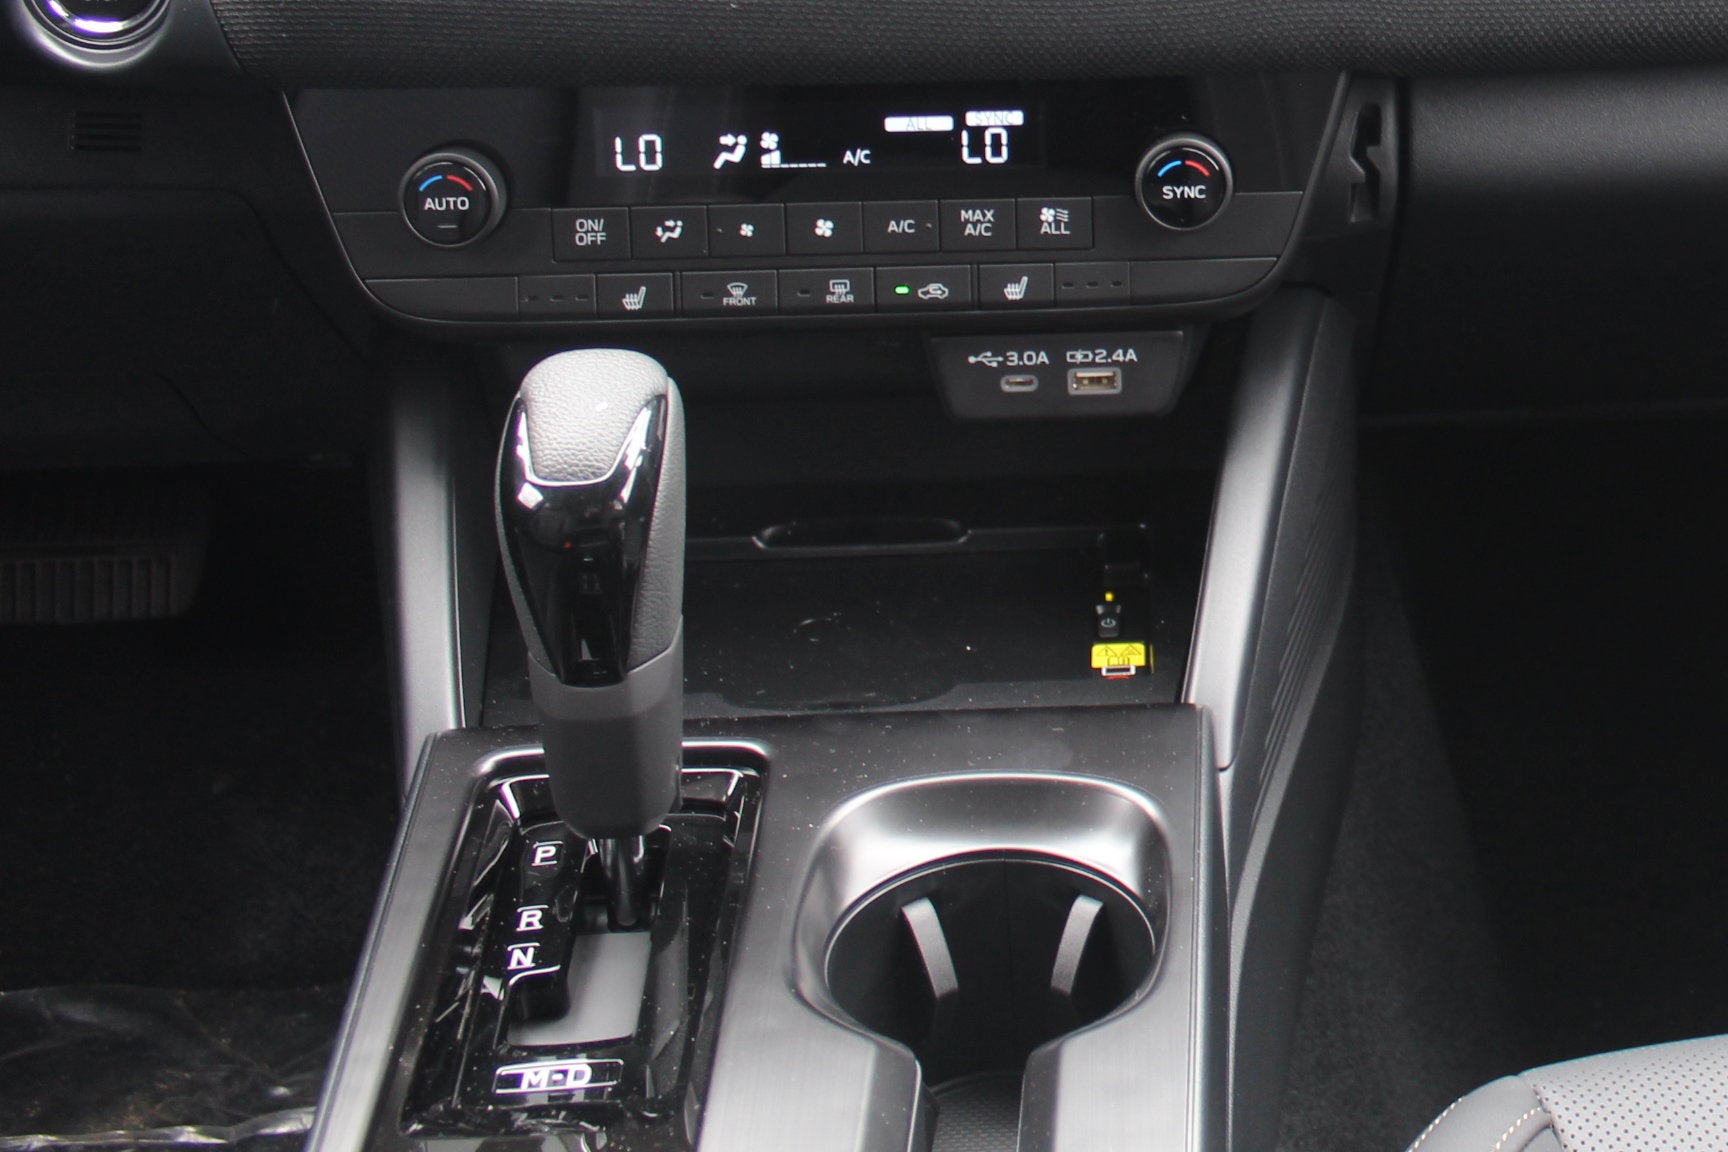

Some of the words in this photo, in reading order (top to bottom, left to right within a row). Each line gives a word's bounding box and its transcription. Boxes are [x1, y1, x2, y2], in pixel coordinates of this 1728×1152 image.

[905, 116, 933, 131] ALL
[974, 111, 1016, 126] SYNC
[614, 133, 664, 172] LO
[960, 126, 1008, 164] LO
[842, 149, 872, 166] A/C
[1161, 185, 1206, 200] SYNC
[424, 196, 470, 212] AUTO
[960, 209, 995, 222] MAX
[575, 218, 604, 233] ON/
[887, 220, 916, 234] A/C
[964, 223, 992, 236] A/C
[1040, 221, 1071, 236] ALL
[575, 233, 606, 247] OFF
[722, 296, 757, 306] FRONT
[825, 294, 854, 304] REAR
[1005, 352, 1050, 366] 3.0A
[1094, 350, 1138, 364] 2.4A
[534, 846, 556, 864] P
[518, 909, 543, 930] R
[508, 946, 535, 968] N
